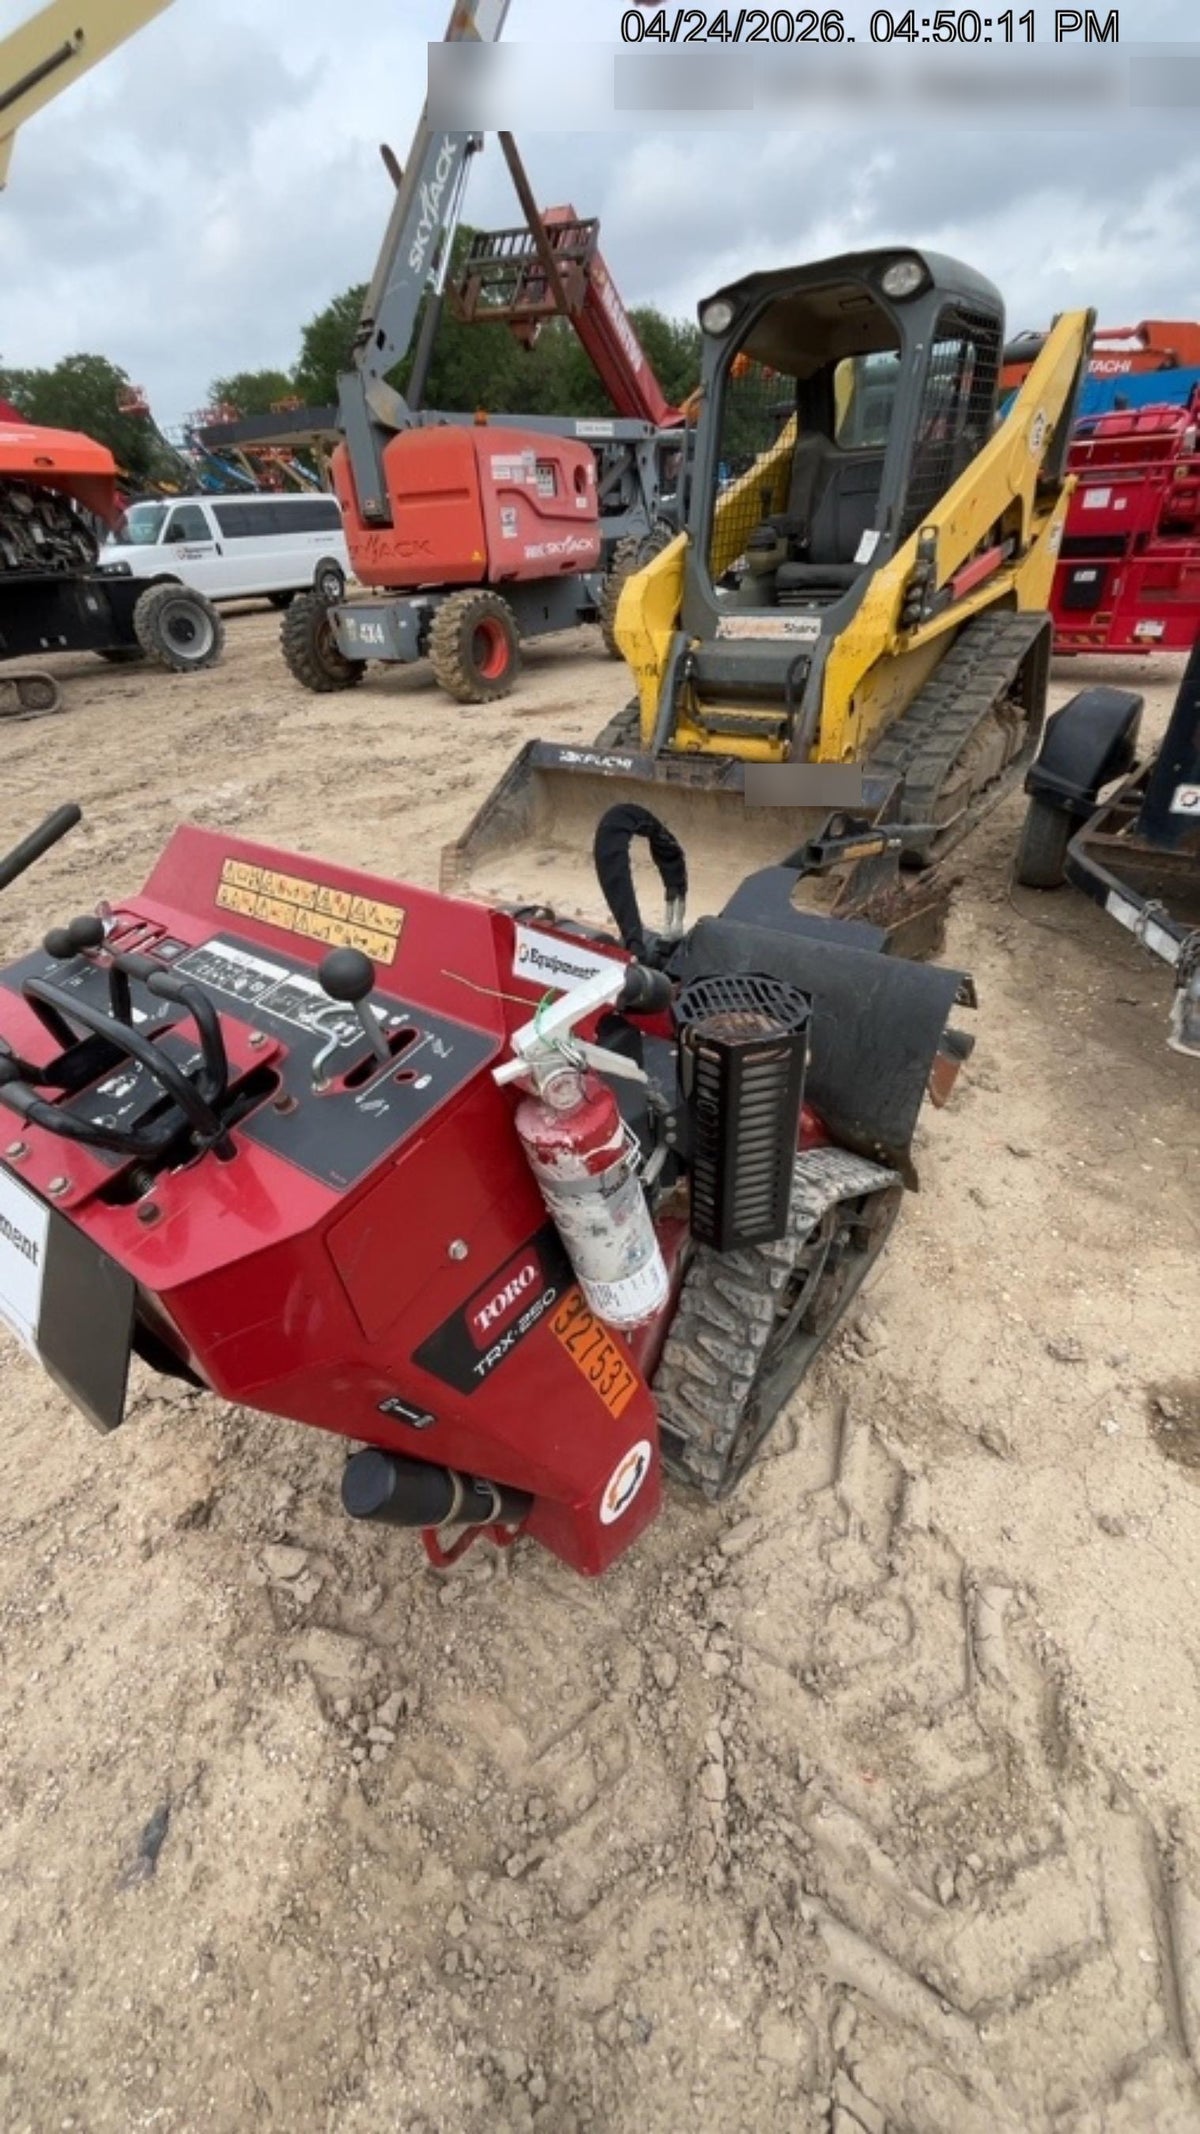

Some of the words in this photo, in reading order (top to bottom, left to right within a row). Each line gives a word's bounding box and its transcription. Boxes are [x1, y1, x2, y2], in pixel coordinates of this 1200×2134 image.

[409, 134, 457, 274] SKYJACK
[1087, 359, 1131, 373] TACHI
[474, 1265, 536, 1330] TORO
[555, 1294, 633, 1407] 327537
